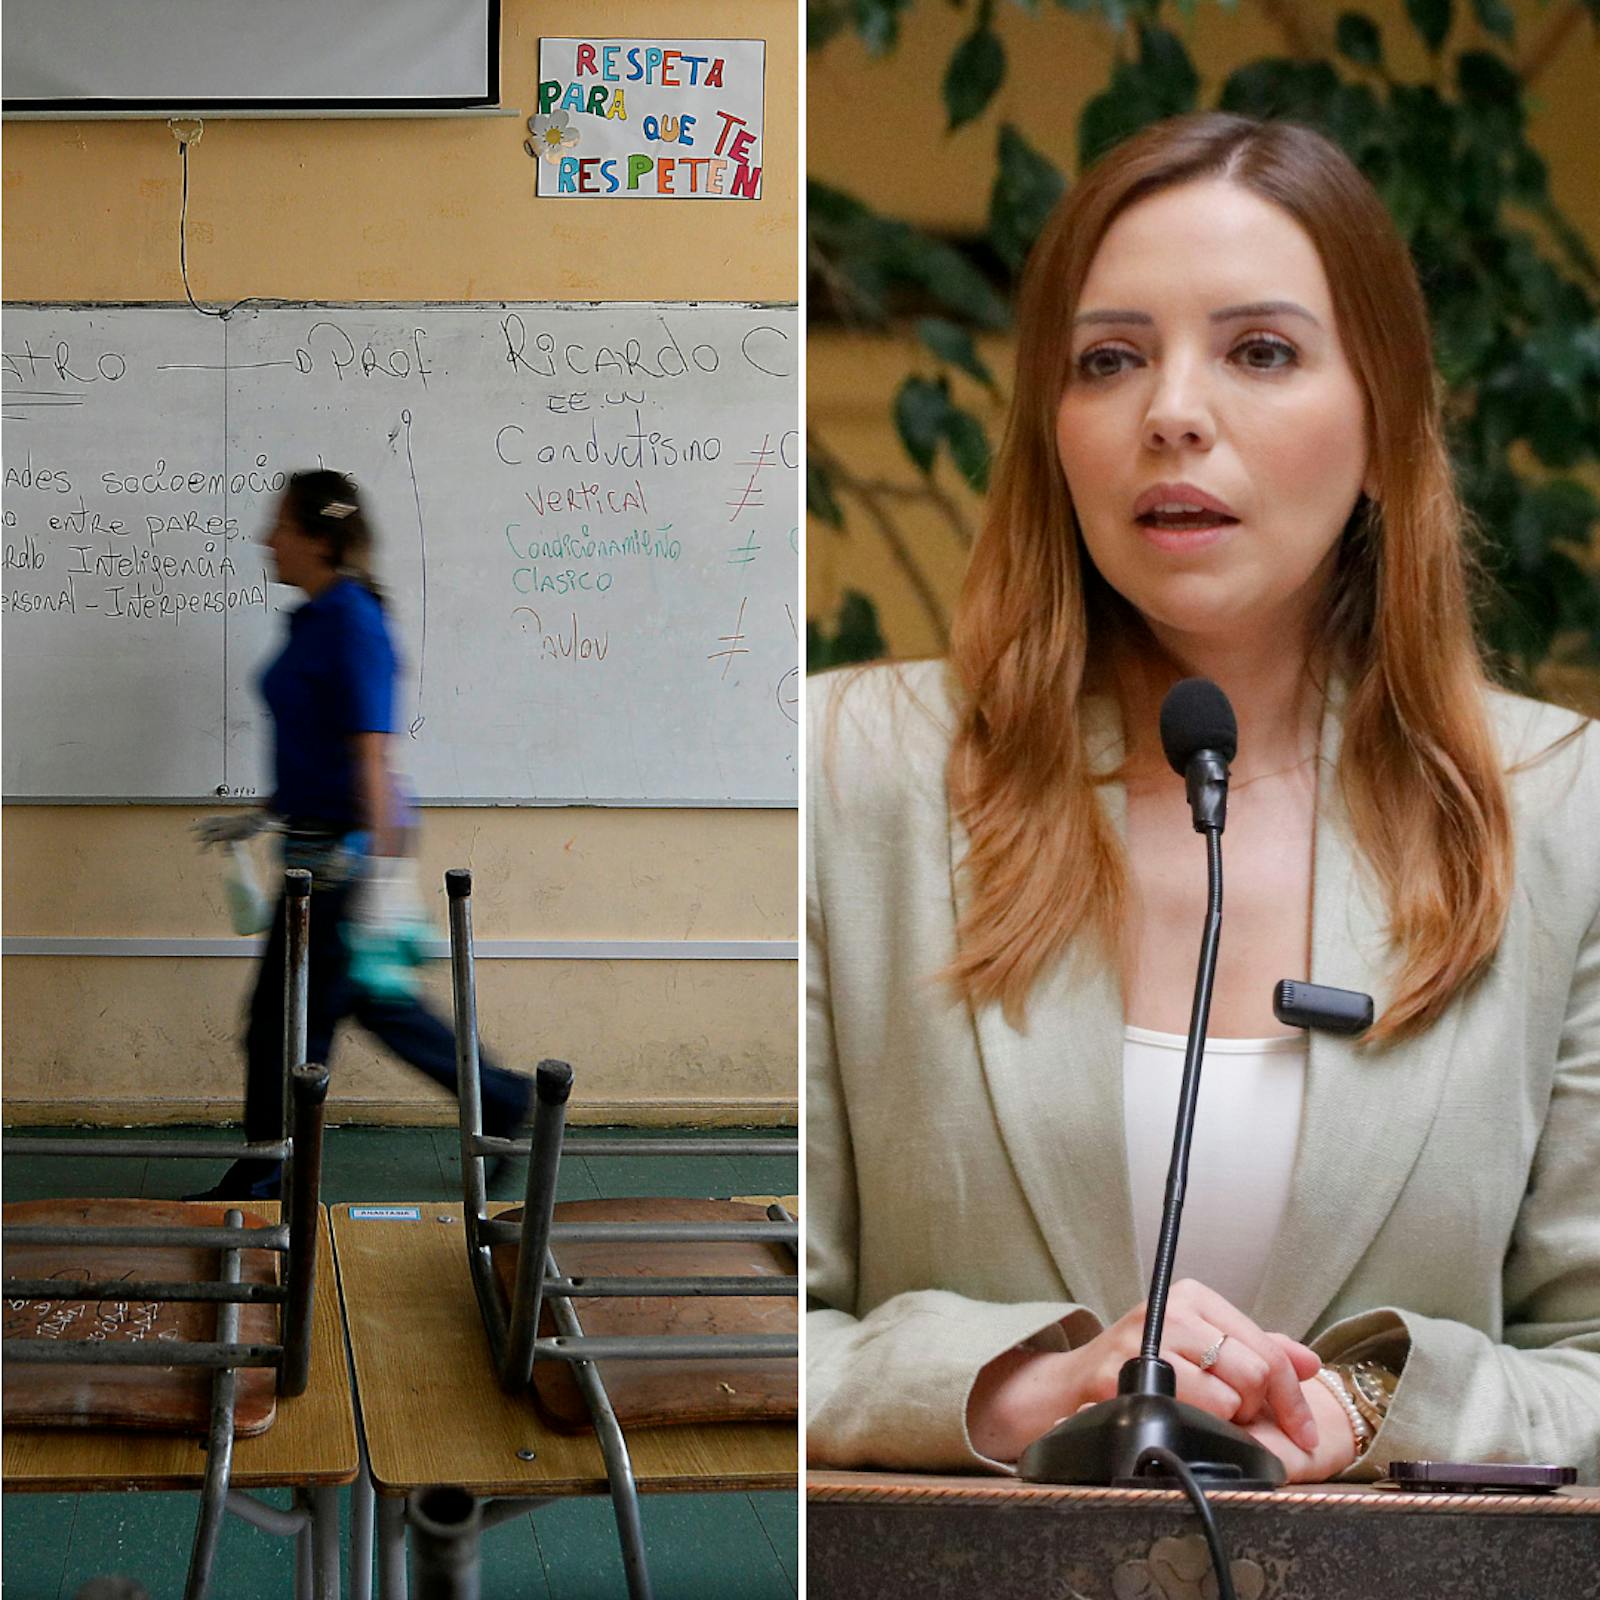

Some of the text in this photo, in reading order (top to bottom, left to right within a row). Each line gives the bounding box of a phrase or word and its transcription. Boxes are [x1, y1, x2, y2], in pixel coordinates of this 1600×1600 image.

[577, 43, 724, 88] RESPETA
[540, 80, 757, 165] PARA QUE TE
[558, 154, 761, 199] RESPETEN
